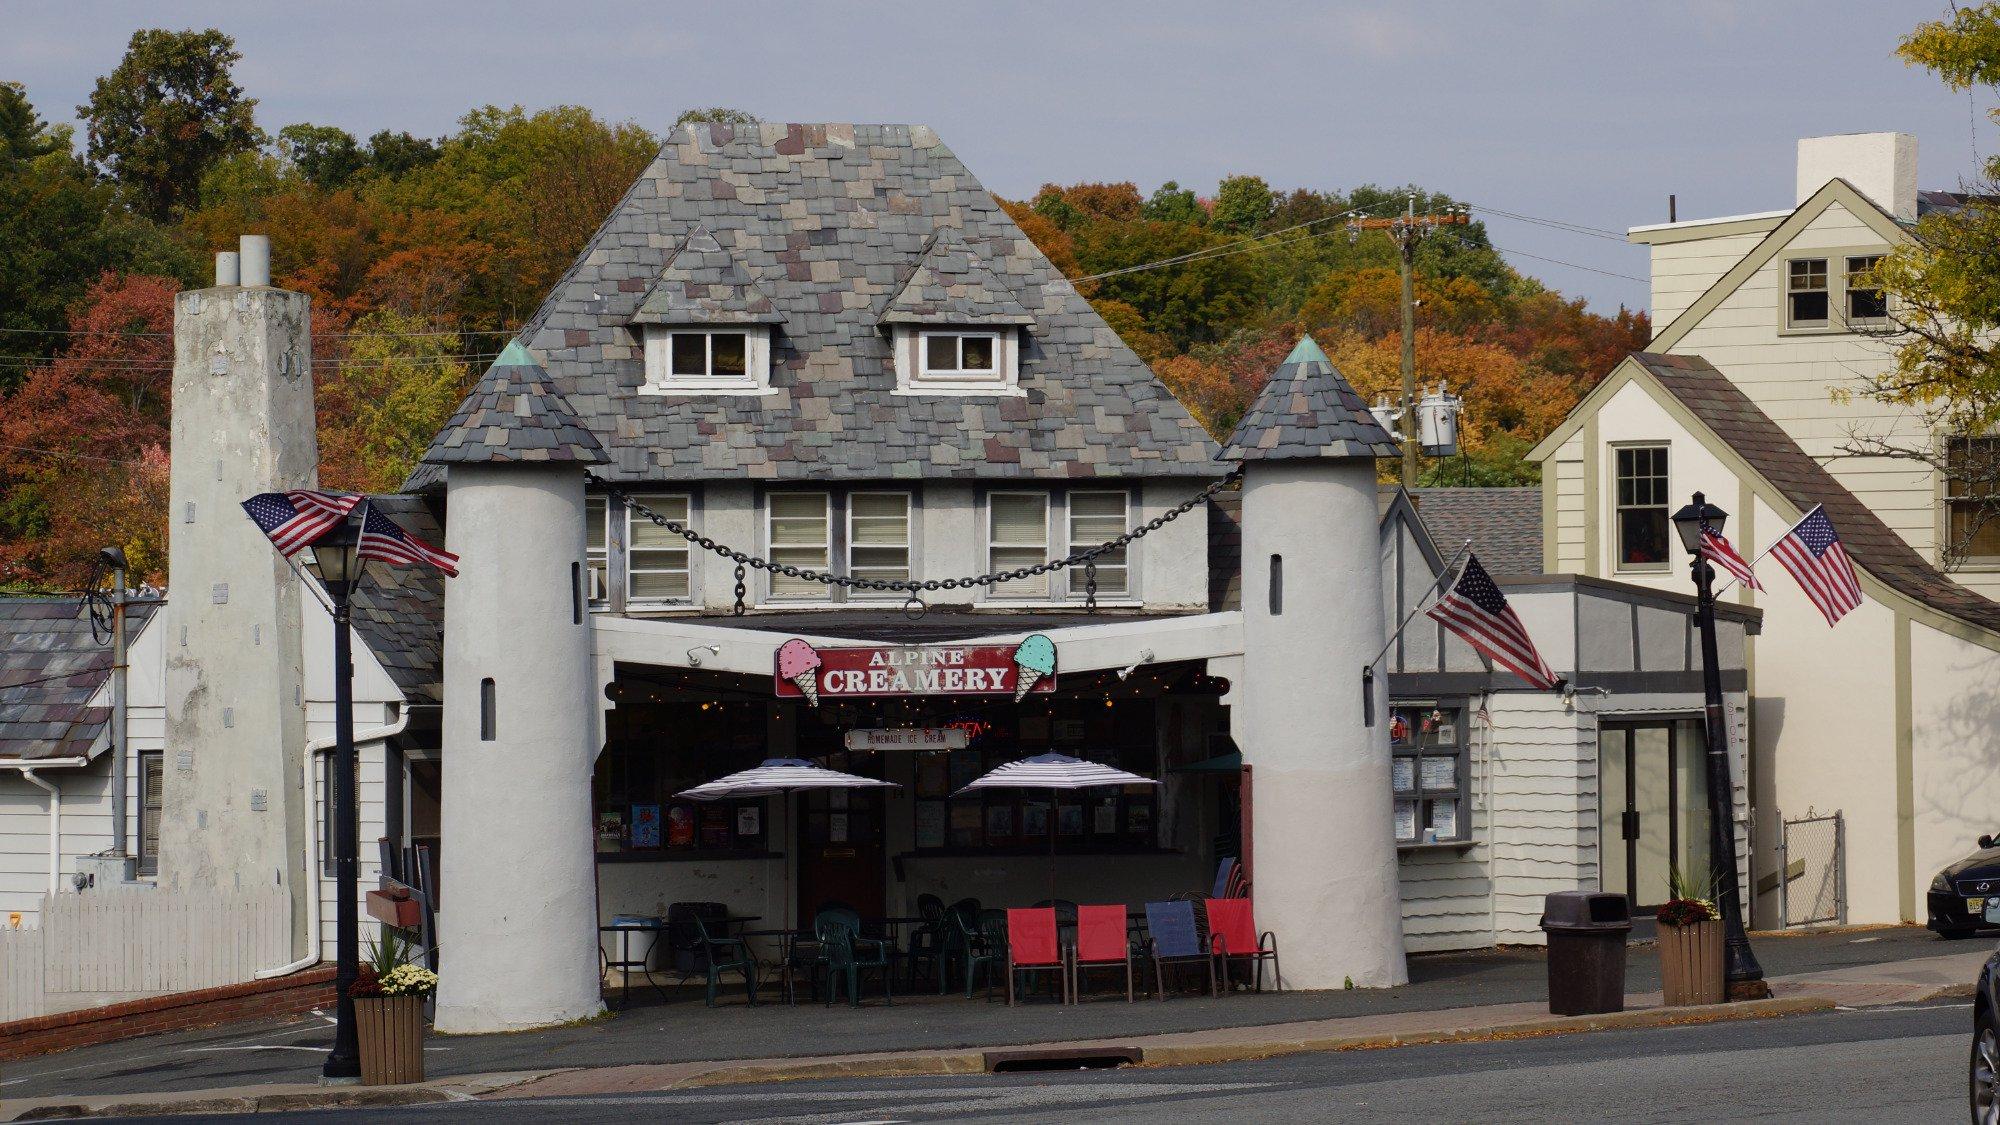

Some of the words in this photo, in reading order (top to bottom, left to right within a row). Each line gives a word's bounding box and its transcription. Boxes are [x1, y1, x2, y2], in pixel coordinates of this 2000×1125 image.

[868, 651, 964, 666] ALPINE
[823, 669, 1008, 692] CREAMERY
[1727, 702, 1737, 747] STOP
[867, 734, 901, 744] HOMEMADE
[907, 734, 917, 744] ICE
[924, 734, 946, 744] CREAM
